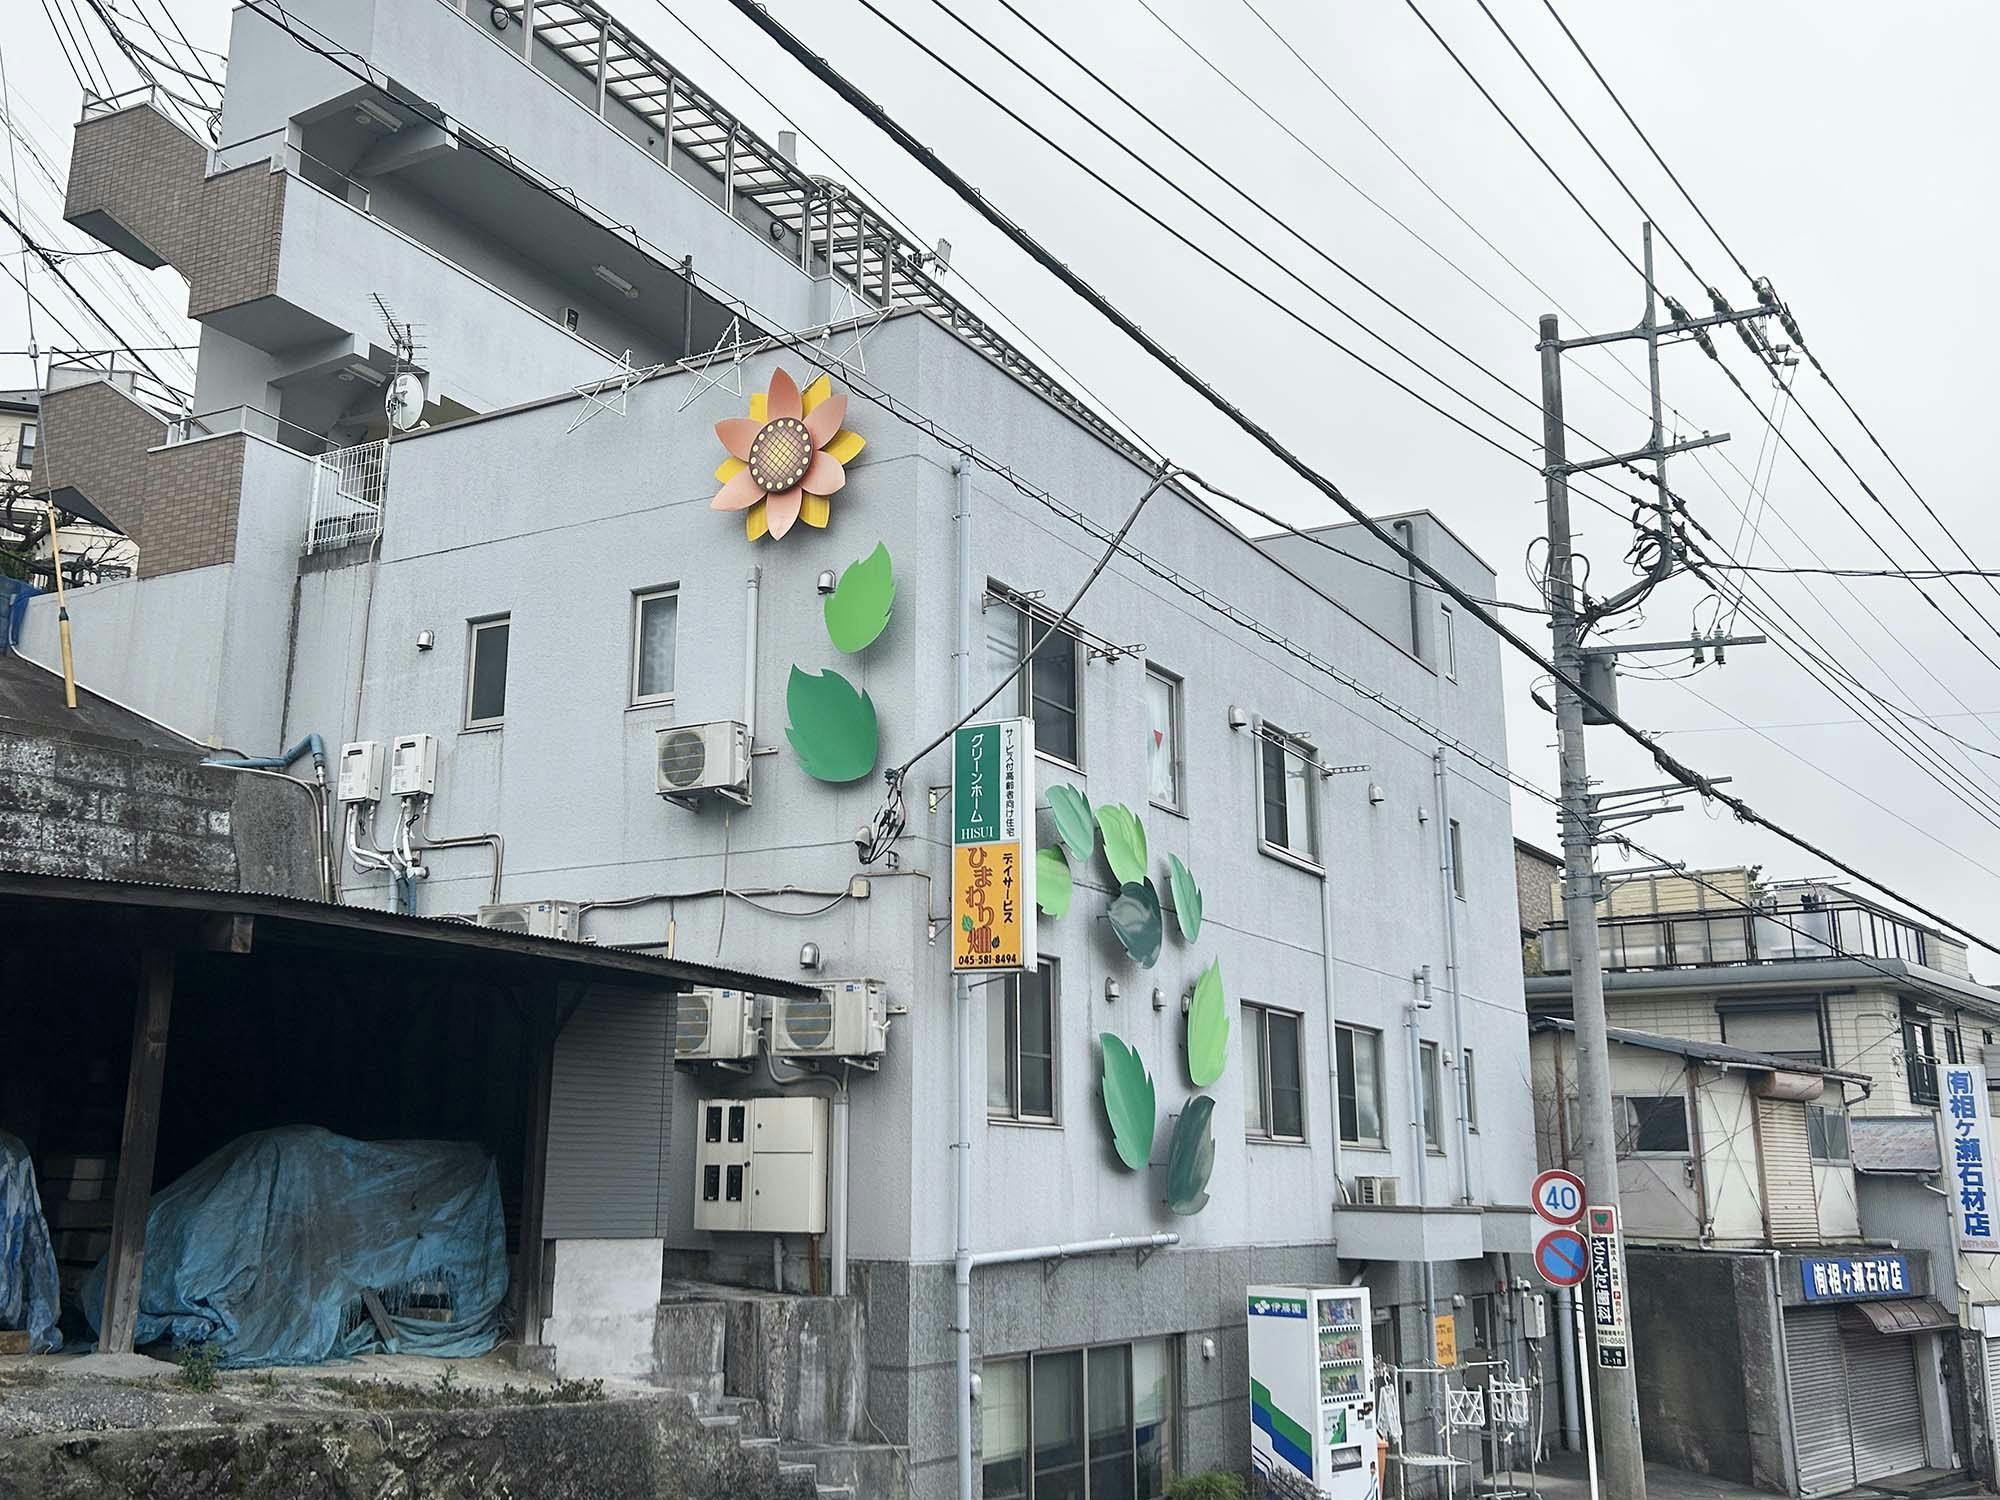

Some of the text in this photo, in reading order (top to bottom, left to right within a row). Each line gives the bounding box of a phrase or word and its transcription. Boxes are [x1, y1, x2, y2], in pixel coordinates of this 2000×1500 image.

[971, 733, 984, 822] グリーンホーム
[1005, 728, 1015, 837] サービス付高齢者向け住宅
[961, 826, 993, 840] HISUI
[965, 847, 995, 954] ひまわり畑
[1003, 853, 1013, 923] デイサービス
[958, 954, 1017, 965] 045-581-8494
[1546, 1186, 1576, 1210] 40
